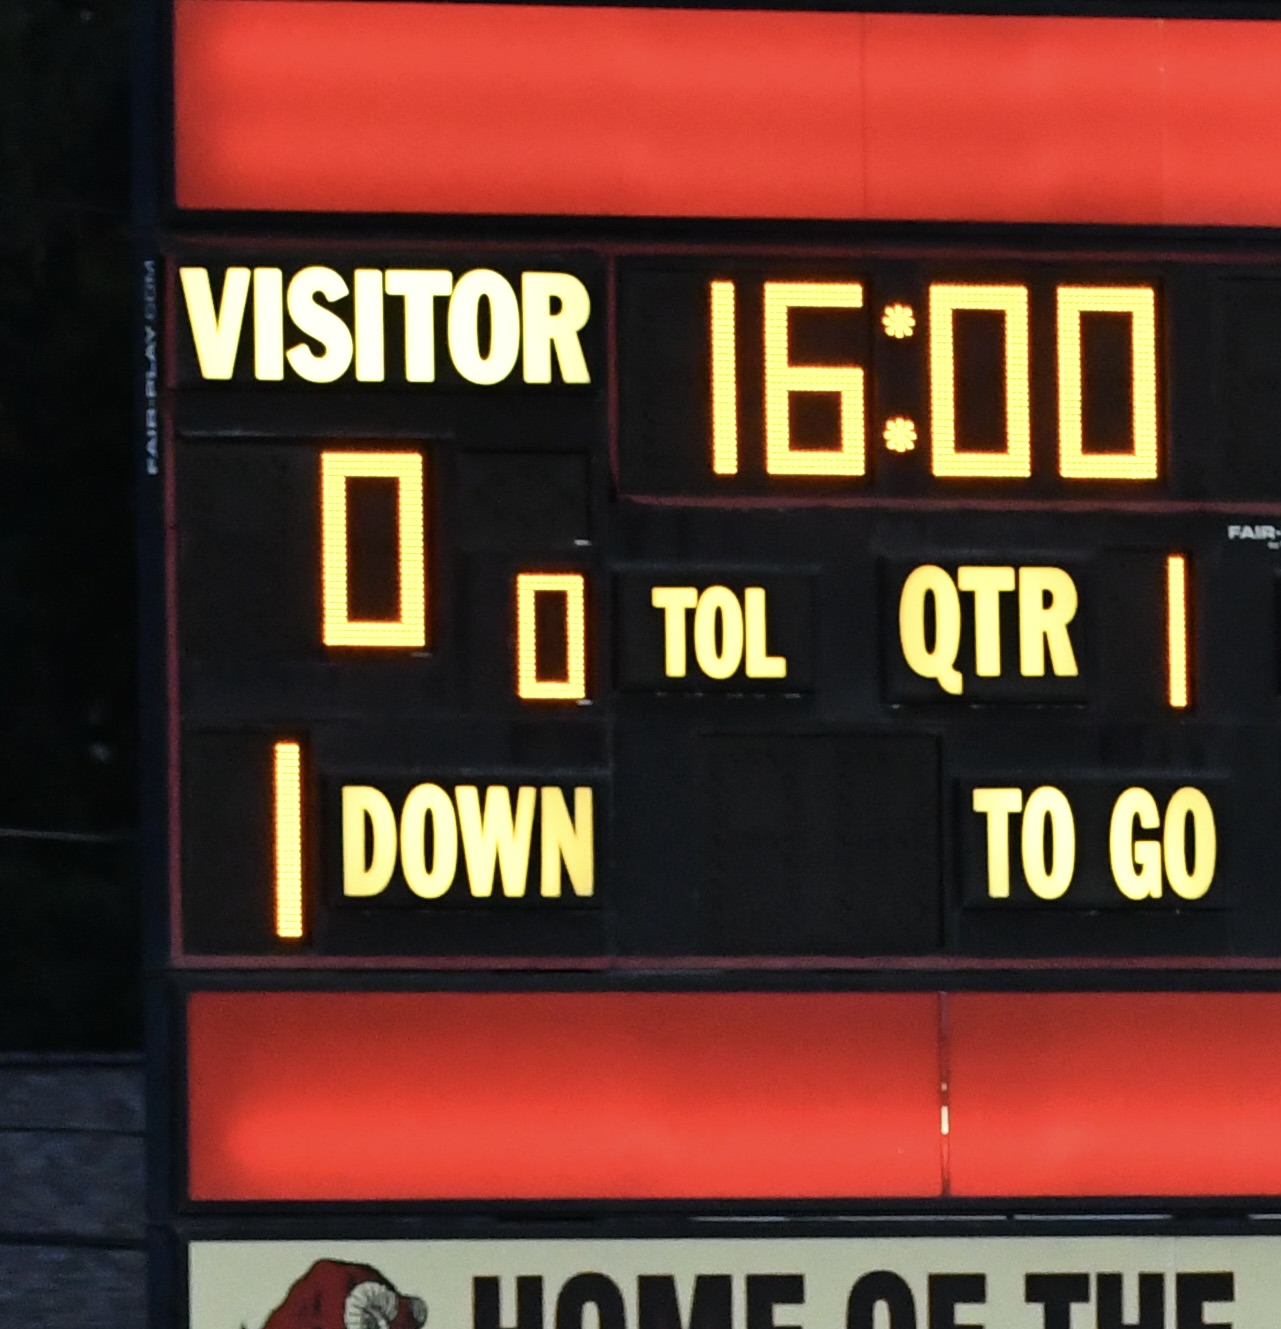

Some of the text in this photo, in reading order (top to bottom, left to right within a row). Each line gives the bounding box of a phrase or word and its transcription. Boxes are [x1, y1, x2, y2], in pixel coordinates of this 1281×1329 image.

[177, 264, 593, 388] VISITOR
[708, 279, 1160, 482] 16:00
[319, 450, 428, 649] 0
[514, 572, 588, 702] 0
[649, 583, 789, 682] TOL
[897, 563, 1080, 697] QTR
[1165, 554, 1190, 709] 1
[272, 741, 305, 940] 1
[340, 781, 596, 901] DOWN
[970, 784, 1219, 903] TO GO
